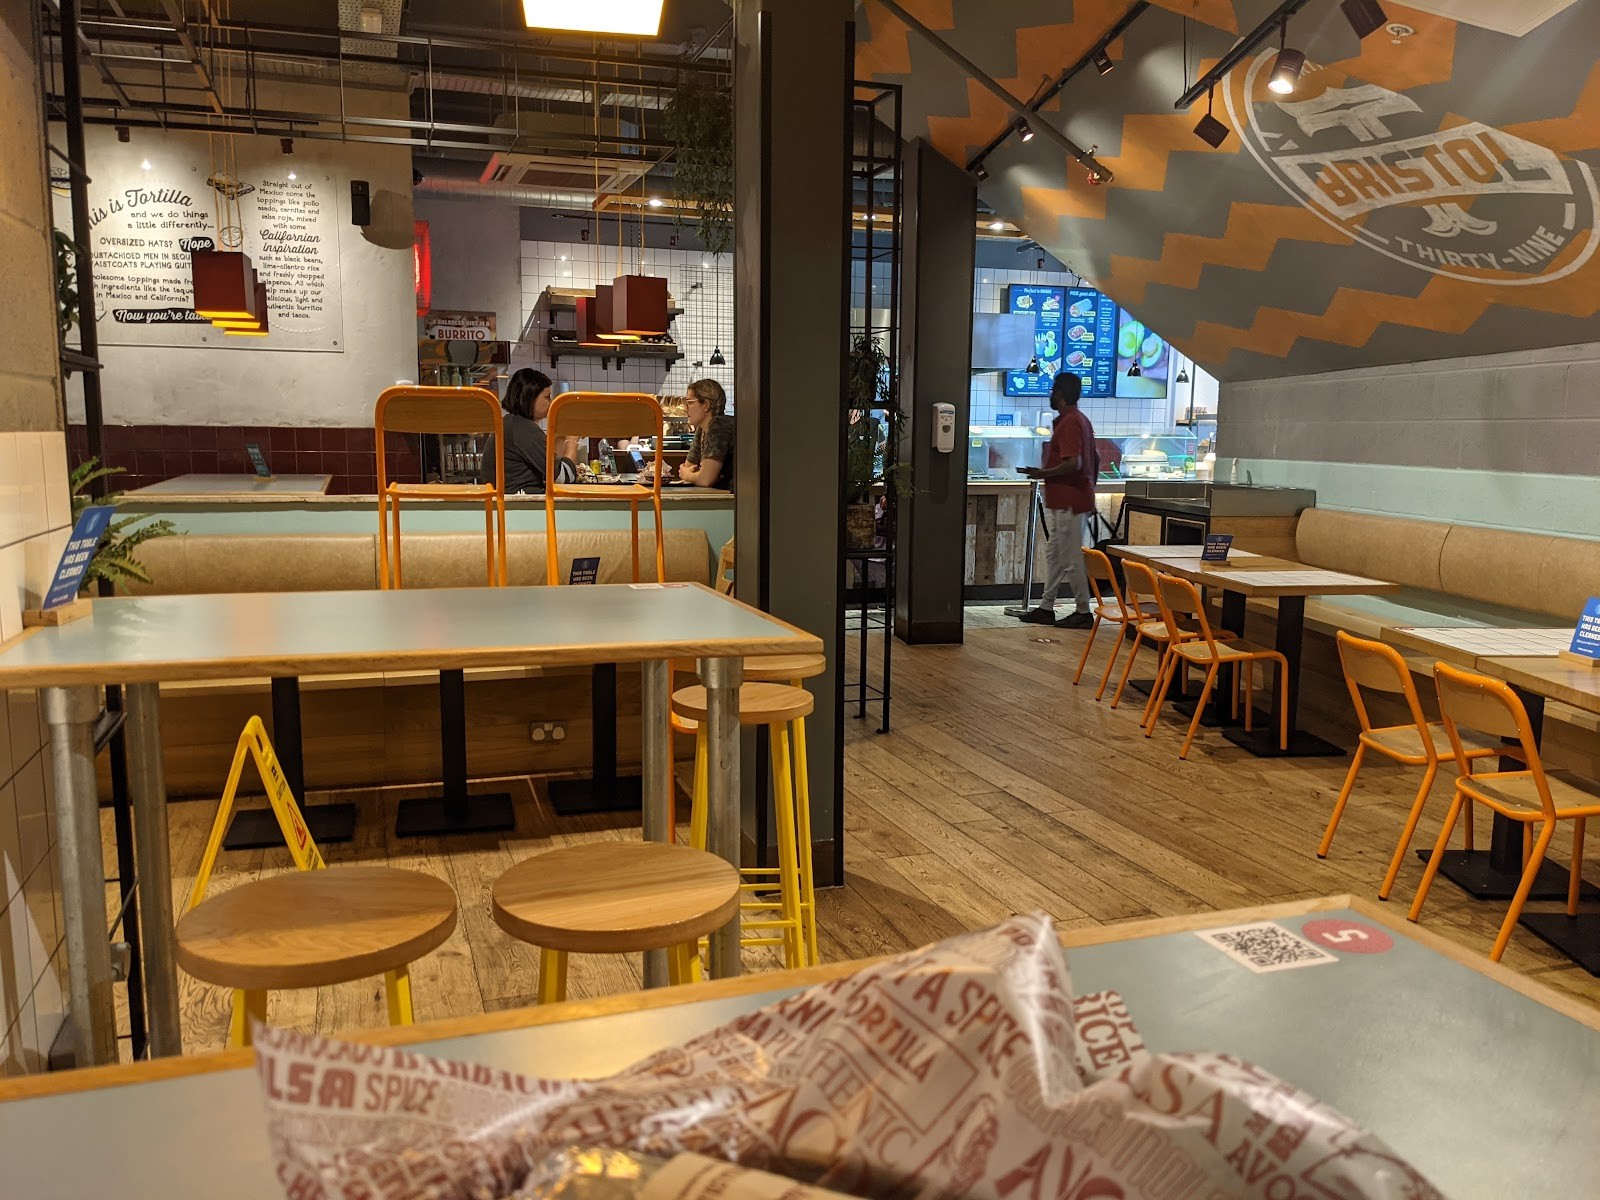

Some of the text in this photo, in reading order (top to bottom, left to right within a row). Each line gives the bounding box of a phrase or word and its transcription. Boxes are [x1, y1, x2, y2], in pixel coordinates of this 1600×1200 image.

[1296, 130, 1553, 208] BRISTOL
[263, 180, 289, 189] Straight
[109, 199, 124, 214] is
[125, 188, 193, 208] Tortilla
[257, 197, 286, 205] toppings
[183, 210, 209, 220] things
[100, 237, 173, 248] OVERSIZED HATS?
[260, 229, 321, 244] Californian
[180, 239, 212, 251] Nope
[263, 243, 318, 255] inspiration
[1394, 225, 1567, 270] THIRTY-NINE
[172, 253, 191, 261] SEQU
[91, 261, 138, 269] AISTCOATS
[128, 276, 160, 285] toppings
[274, 271, 294, 279] freshly
[297, 272, 324, 280] chopped
[101, 283, 141, 292] ingredients
[173, 286, 194, 295] taque
[105, 292, 132, 300] Mexico
[151, 294, 190, 302] California?
[295, 296, 308, 304] light
[115, 309, 144, 322] Now
[438, 329, 485, 340] BURRITO
[68, 537, 98, 551] THIS TABLE
[63, 551, 90, 566] HAS BEEN
[59, 565, 83, 580] CLEANED
[1321, 928, 1369, 943] 5
